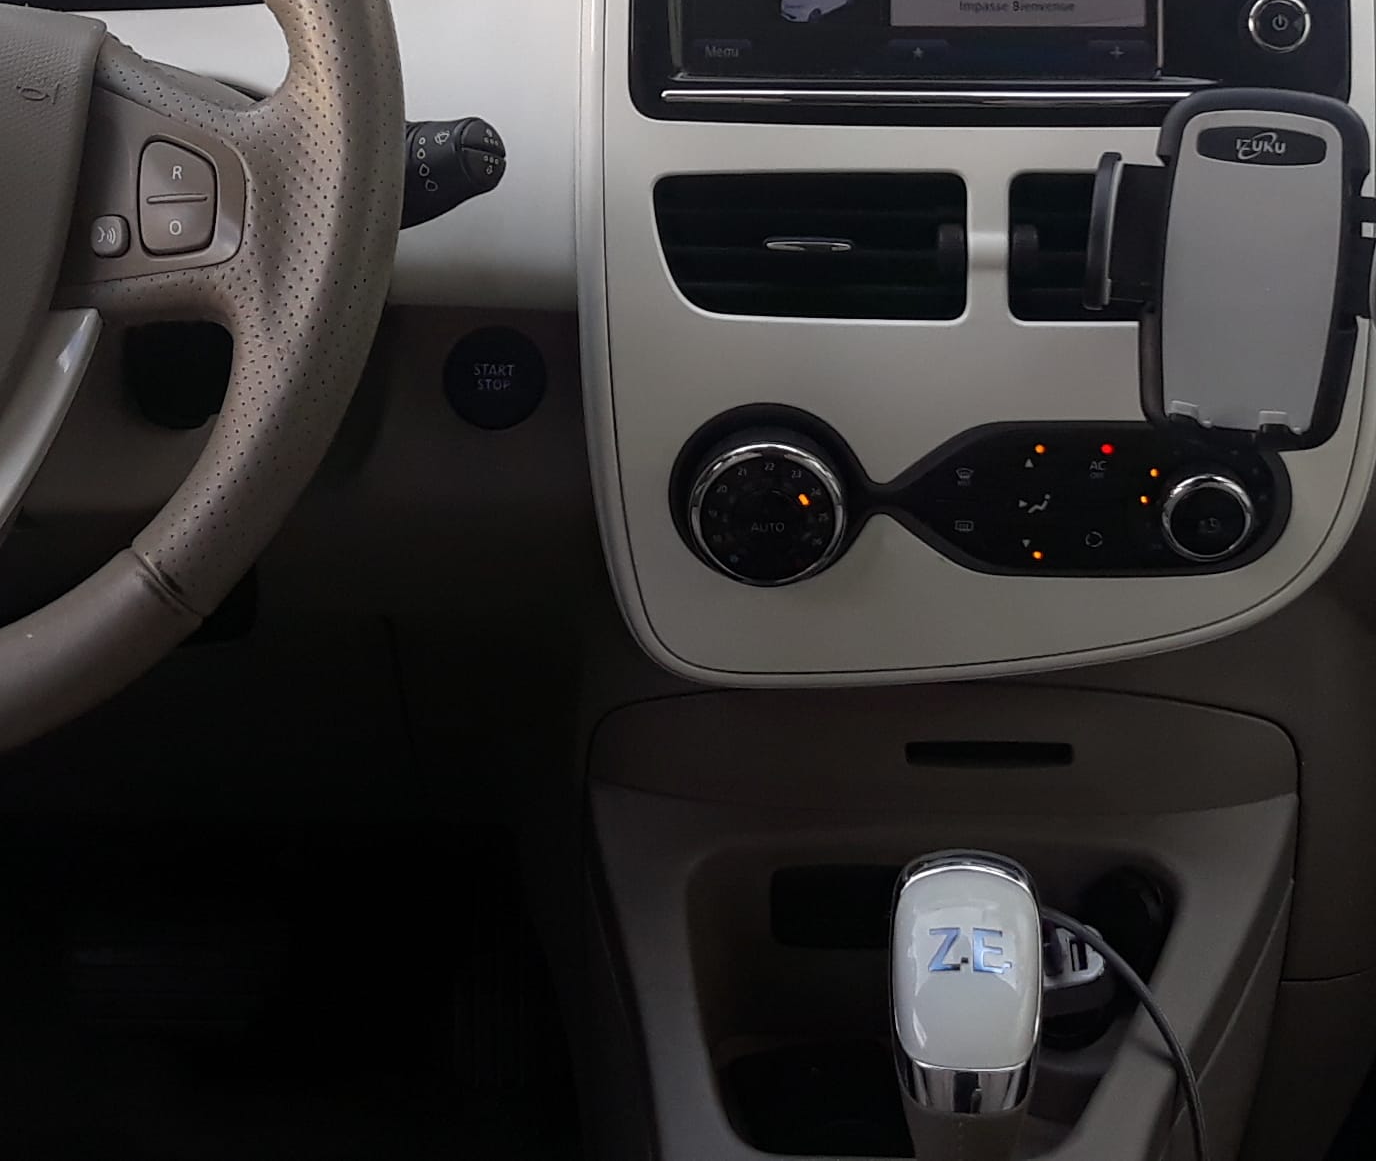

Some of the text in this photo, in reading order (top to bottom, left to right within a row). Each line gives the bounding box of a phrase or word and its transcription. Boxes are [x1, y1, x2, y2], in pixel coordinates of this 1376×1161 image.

[171, 165, 182, 180] R
[473, 363, 515, 377] START
[477, 378, 512, 391] STOP
[1089, 460, 1107, 471] AC
[751, 521, 785, 533] AUTO
